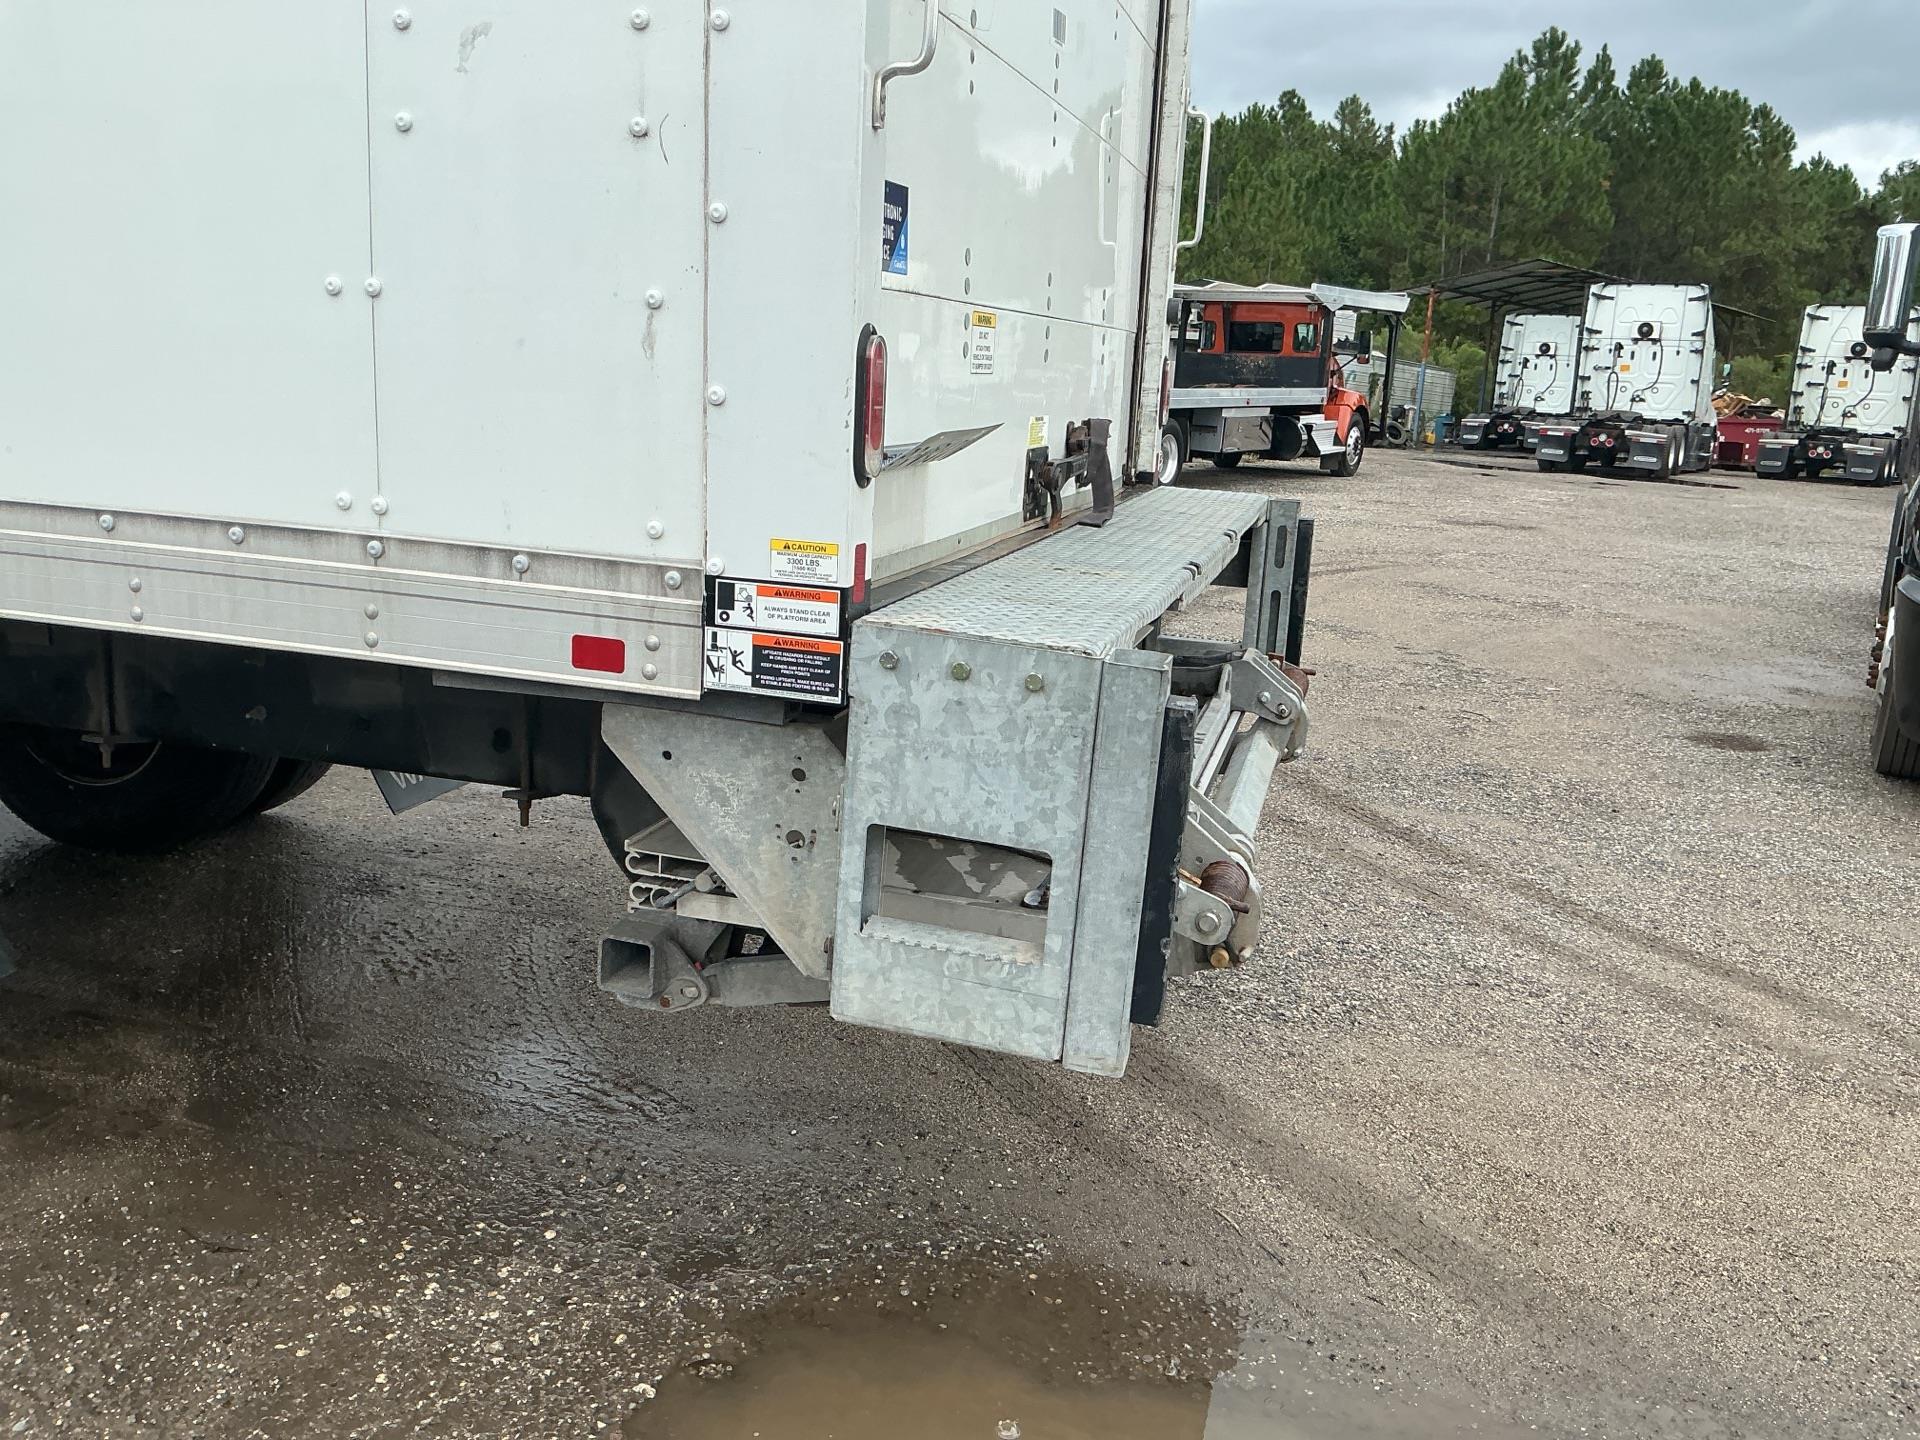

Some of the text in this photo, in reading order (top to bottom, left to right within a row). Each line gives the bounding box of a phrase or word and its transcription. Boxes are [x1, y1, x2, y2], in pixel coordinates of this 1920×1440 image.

[791, 543, 826, 552] CAUTION
[806, 559, 822, 567] LBS.
[782, 590, 820, 600] WARNING
[777, 614, 809, 622] PLATFORM
[781, 639, 819, 650] WARNING
